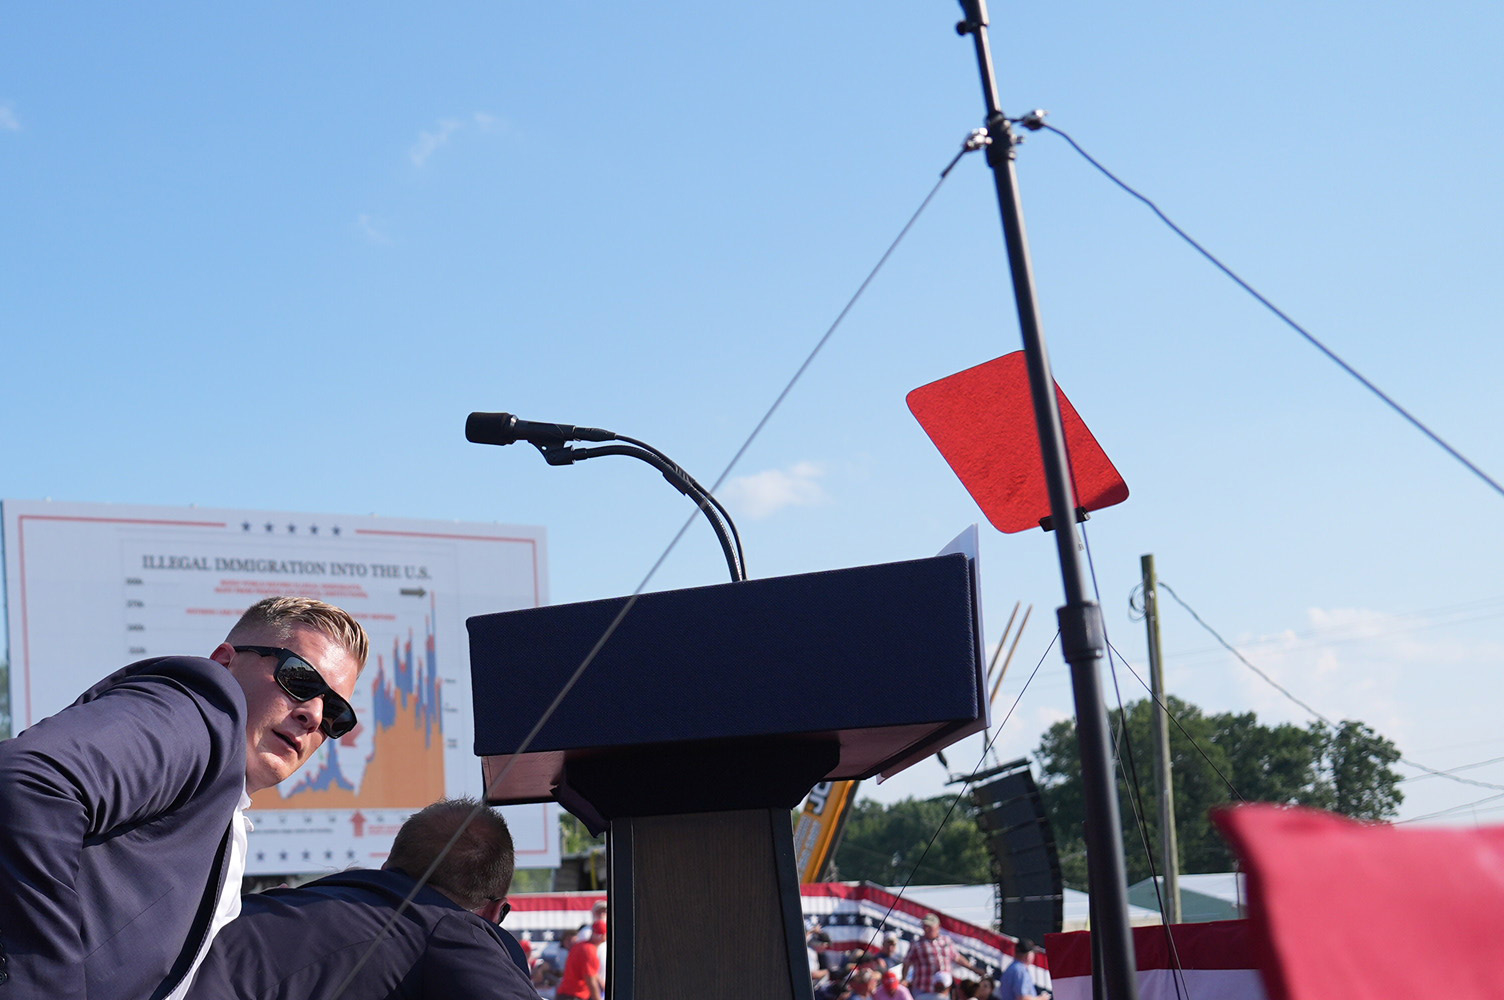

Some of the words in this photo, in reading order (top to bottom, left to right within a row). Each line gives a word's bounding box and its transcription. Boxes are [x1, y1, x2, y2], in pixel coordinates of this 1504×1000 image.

[142, 555, 211, 570] ILLEGAL
[214, 556, 328, 575] IMMIGRATION
[330, 561, 368, 577] INTO
[370, 564, 398, 579] THE
[404, 565, 432, 580] U.S.
[808, 781, 833, 816] JC
